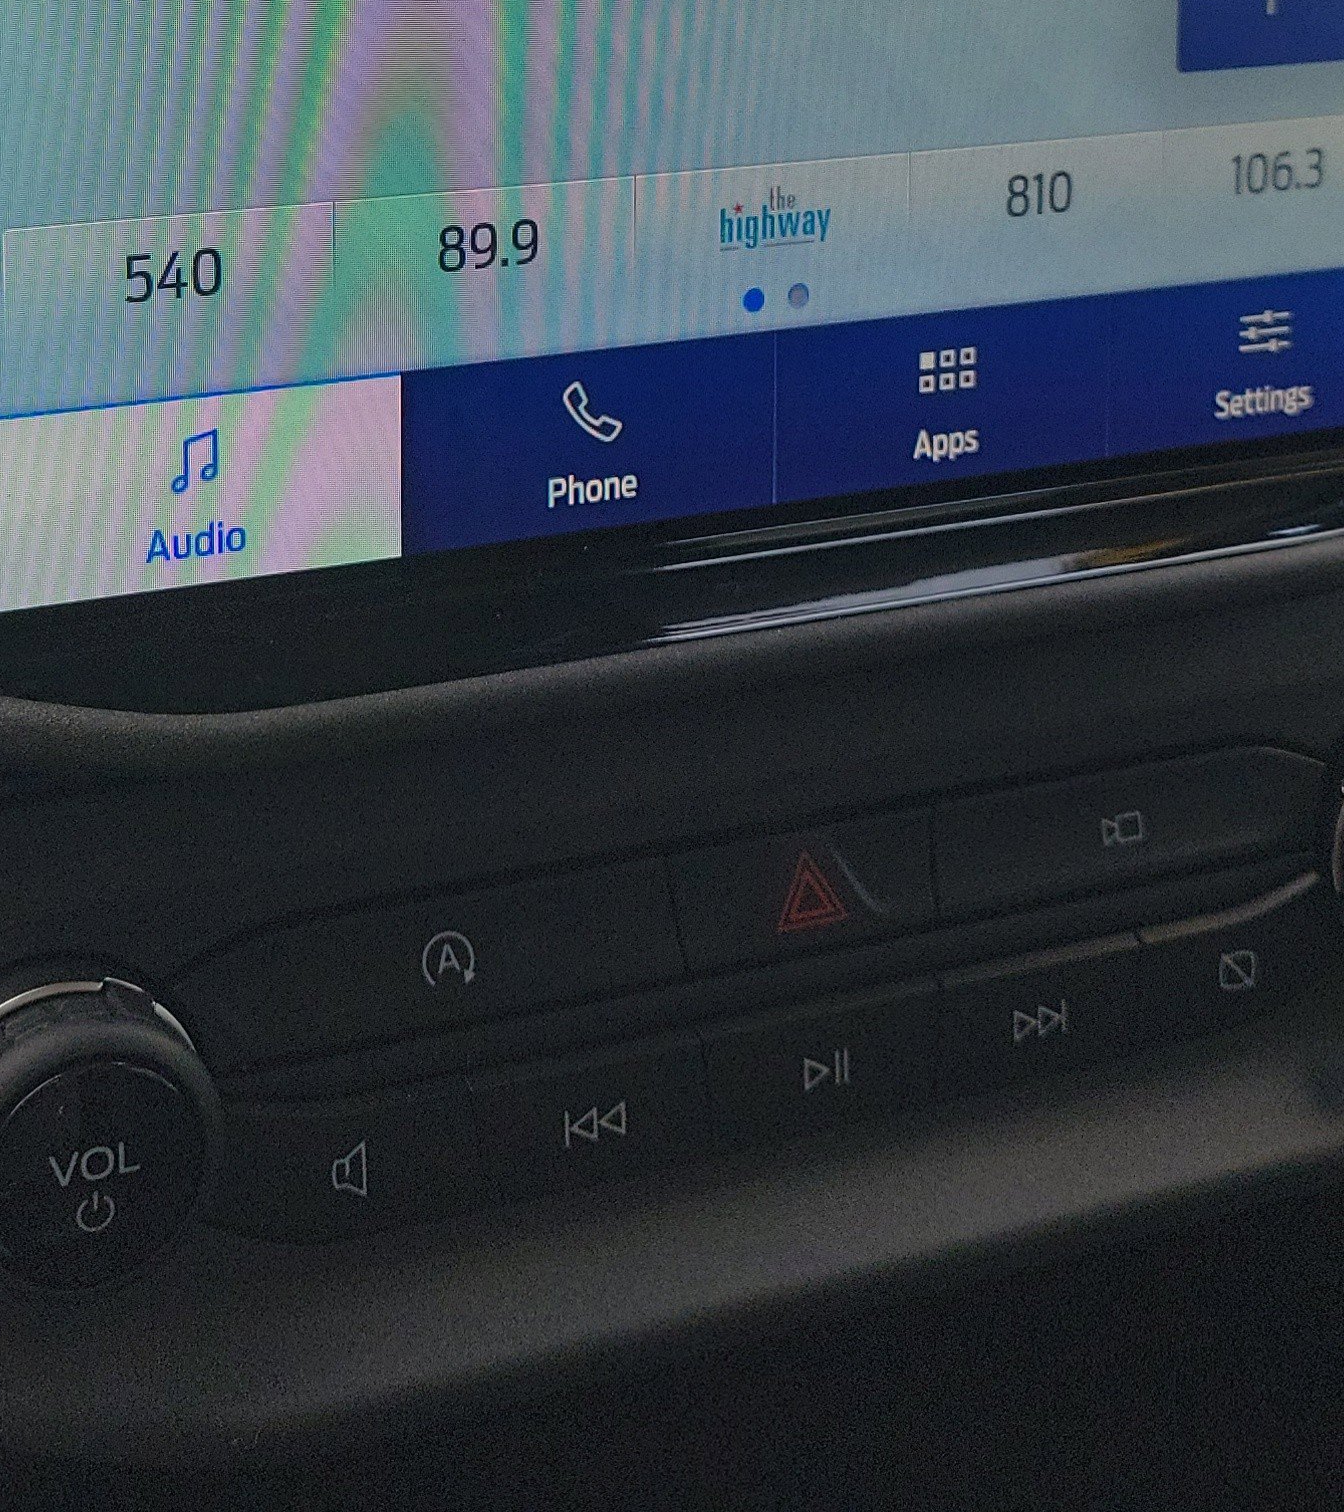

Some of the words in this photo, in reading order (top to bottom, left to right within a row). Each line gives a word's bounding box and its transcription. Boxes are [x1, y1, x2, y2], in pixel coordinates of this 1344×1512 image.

[1006, 170, 1073, 217] 810
[1232, 148, 1325, 195] 106.3
[769, 188, 796, 210] the
[439, 219, 540, 273] 89.9
[720, 204, 831, 250] highway
[125, 248, 223, 303] 540
[1214, 383, 1312, 419] Settings
[914, 429, 979, 462] Apps
[547, 473, 638, 508] Phone
[146, 522, 247, 564] Audio
[49, 1142, 141, 1187] VOL
